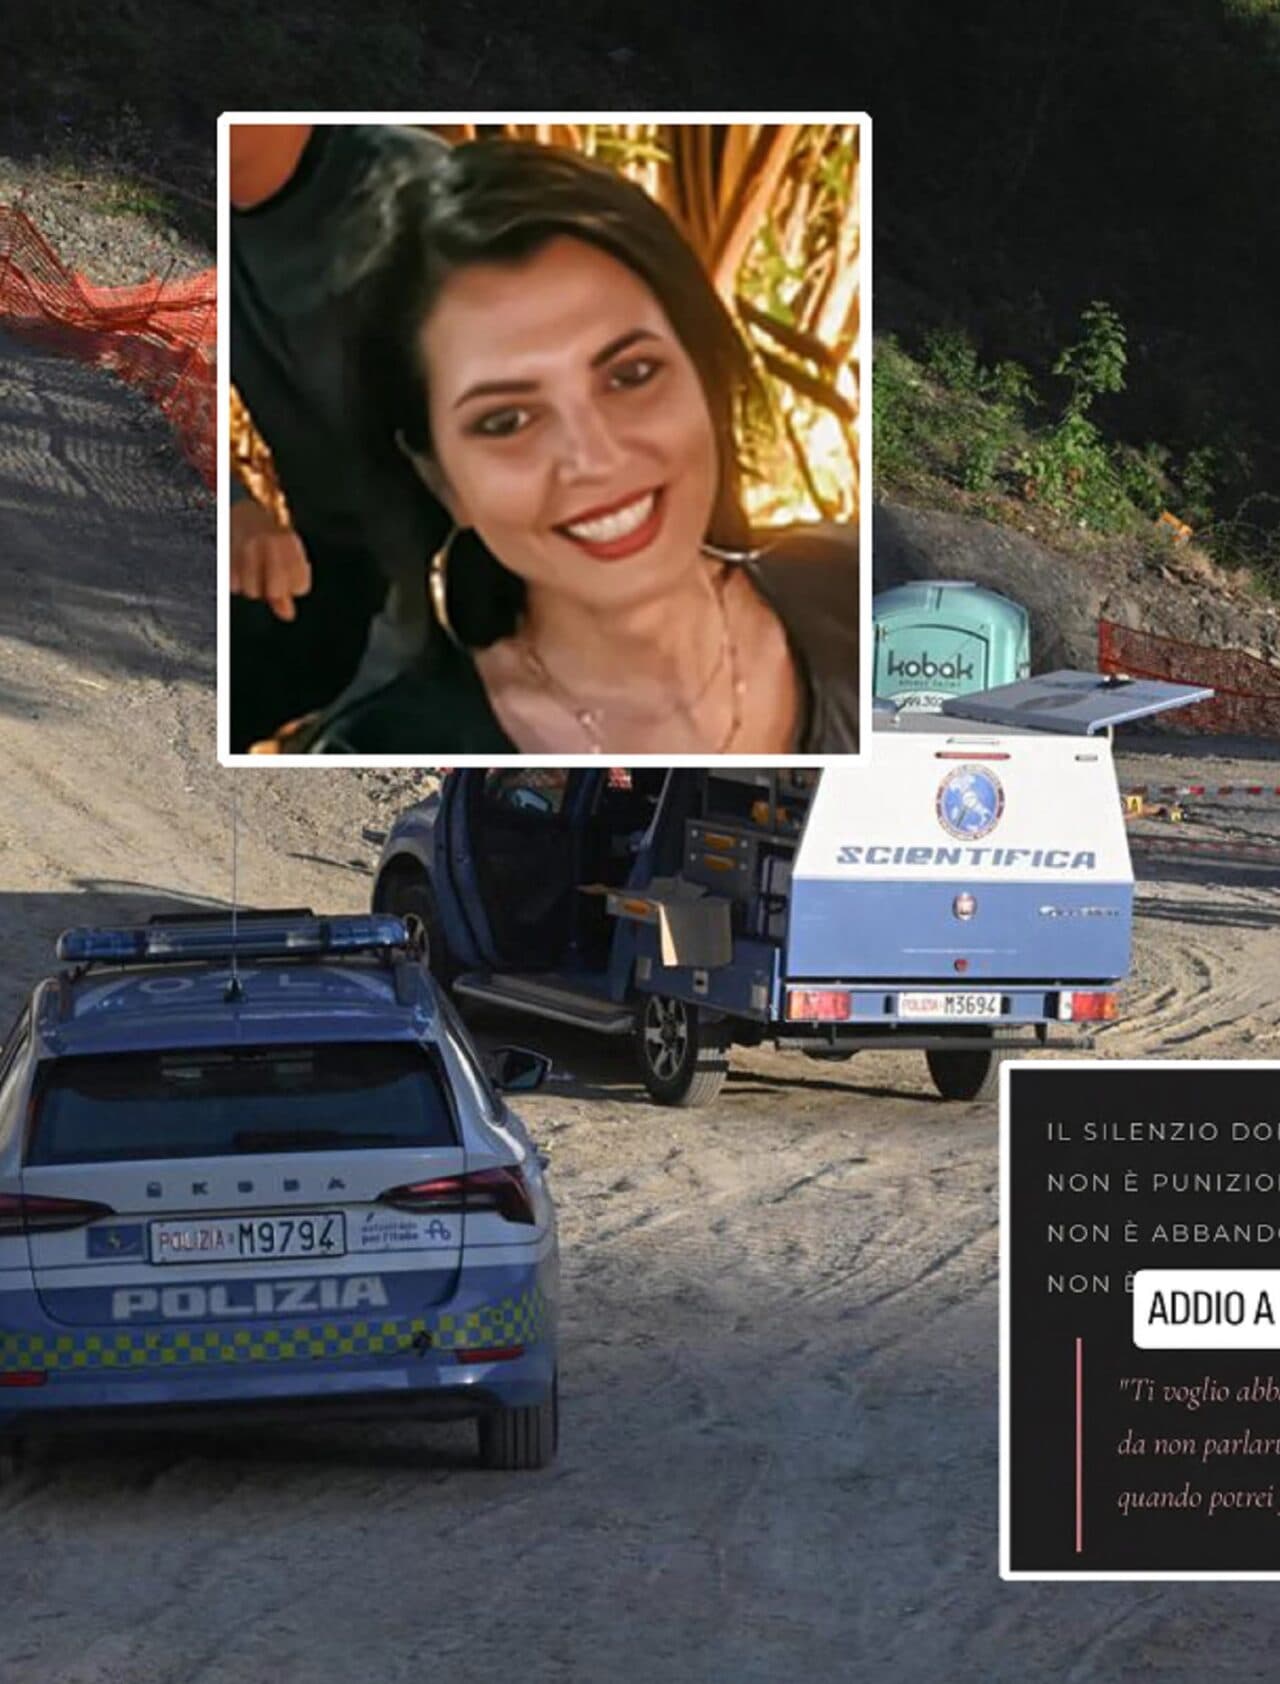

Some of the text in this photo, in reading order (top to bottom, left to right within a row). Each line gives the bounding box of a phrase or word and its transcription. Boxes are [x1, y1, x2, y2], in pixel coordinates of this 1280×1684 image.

[887, 649, 974, 680] kobak
[944, 995, 996, 1014] M3694
[159, 1220, 335, 1254] POLIZIA M9794
[112, 1276, 388, 1320] POLIZIA
